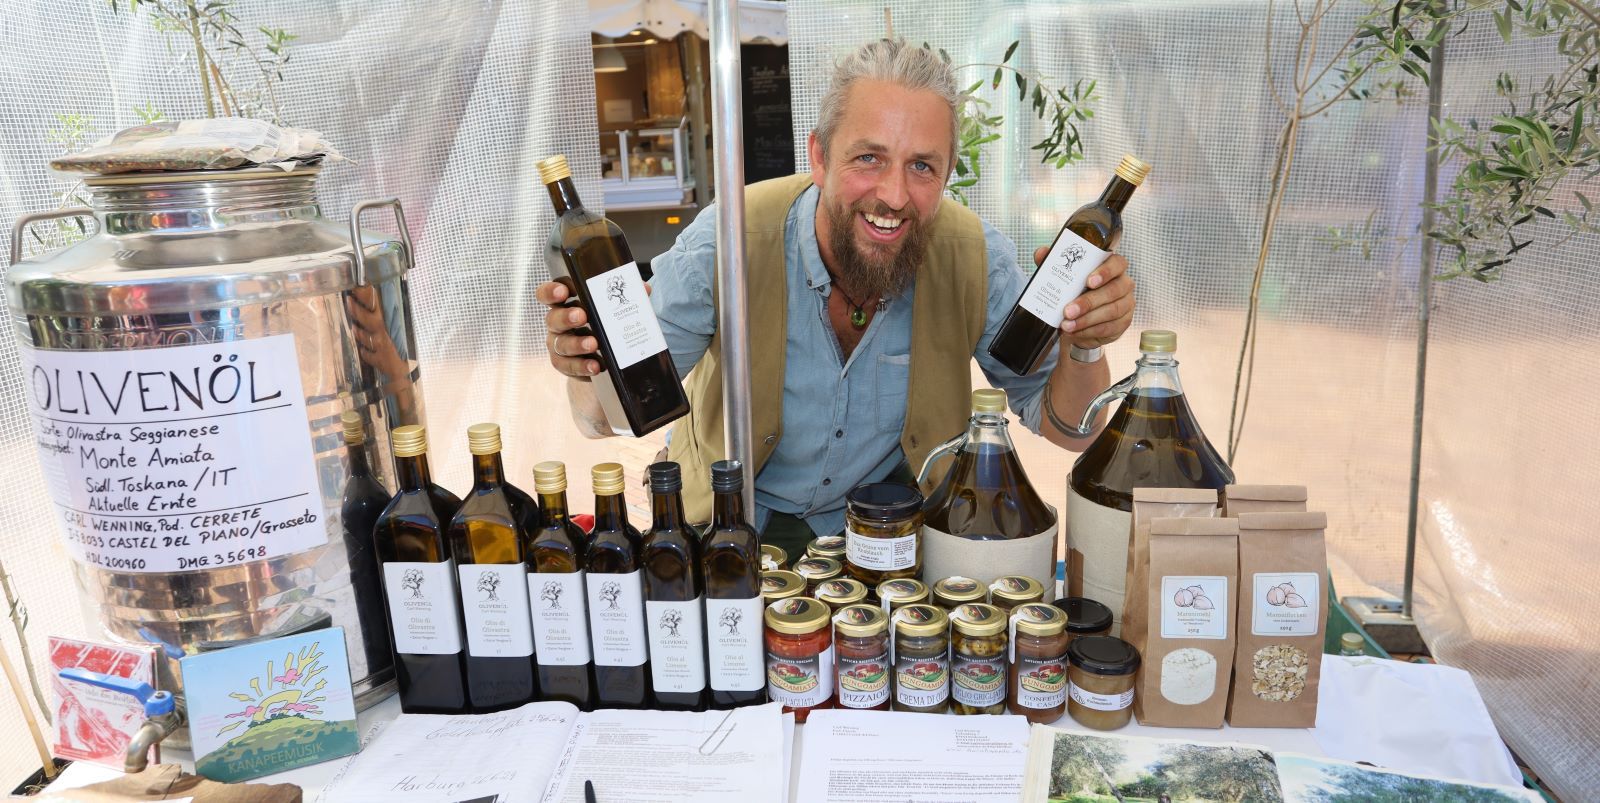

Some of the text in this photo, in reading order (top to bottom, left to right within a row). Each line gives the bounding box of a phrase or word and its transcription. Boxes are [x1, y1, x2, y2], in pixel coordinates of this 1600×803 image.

[32, 354, 282, 415] OLIVENÖL
[67, 426, 122, 441] Olivastra
[129, 425, 220, 445] Seggianese
[80, 446, 137, 468] Monte
[147, 443, 214, 468] Amiata
[117, 475, 188, 492] Toskana
[88, 492, 198, 511] Aktuelle Ernte
[190, 507, 262, 529] CERRETE
[109, 537, 158, 548] CASTEL
[163, 536, 190, 547] DEL
[179, 556, 209, 569] DMG
[899, 692, 924, 706] CREMA
[927, 693, 935, 704] DI
[227, 742, 325, 774] KANAPEEMUSIK
